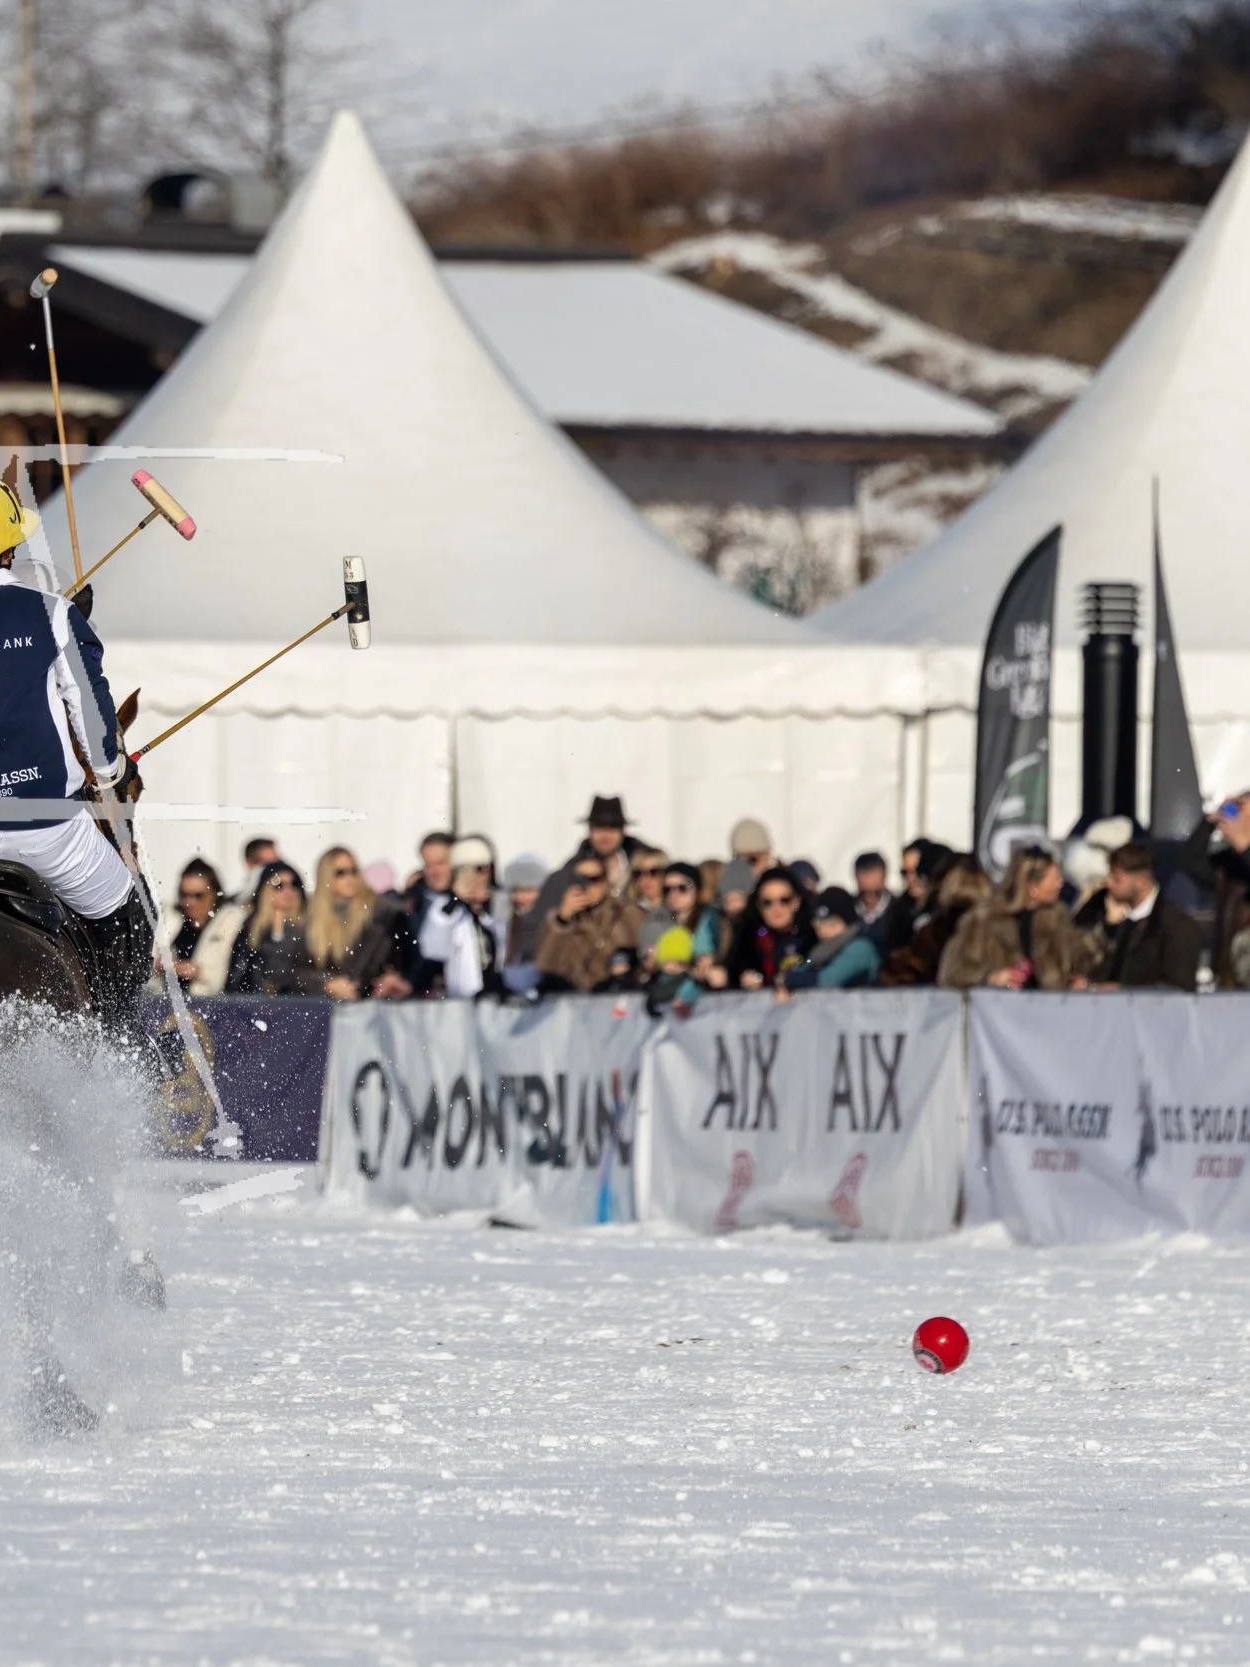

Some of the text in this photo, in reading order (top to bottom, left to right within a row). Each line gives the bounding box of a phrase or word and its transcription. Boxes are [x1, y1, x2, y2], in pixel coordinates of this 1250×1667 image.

[0, 766, 42, 787] ASSN.
[702, 1033, 907, 1133] AIX AIX
